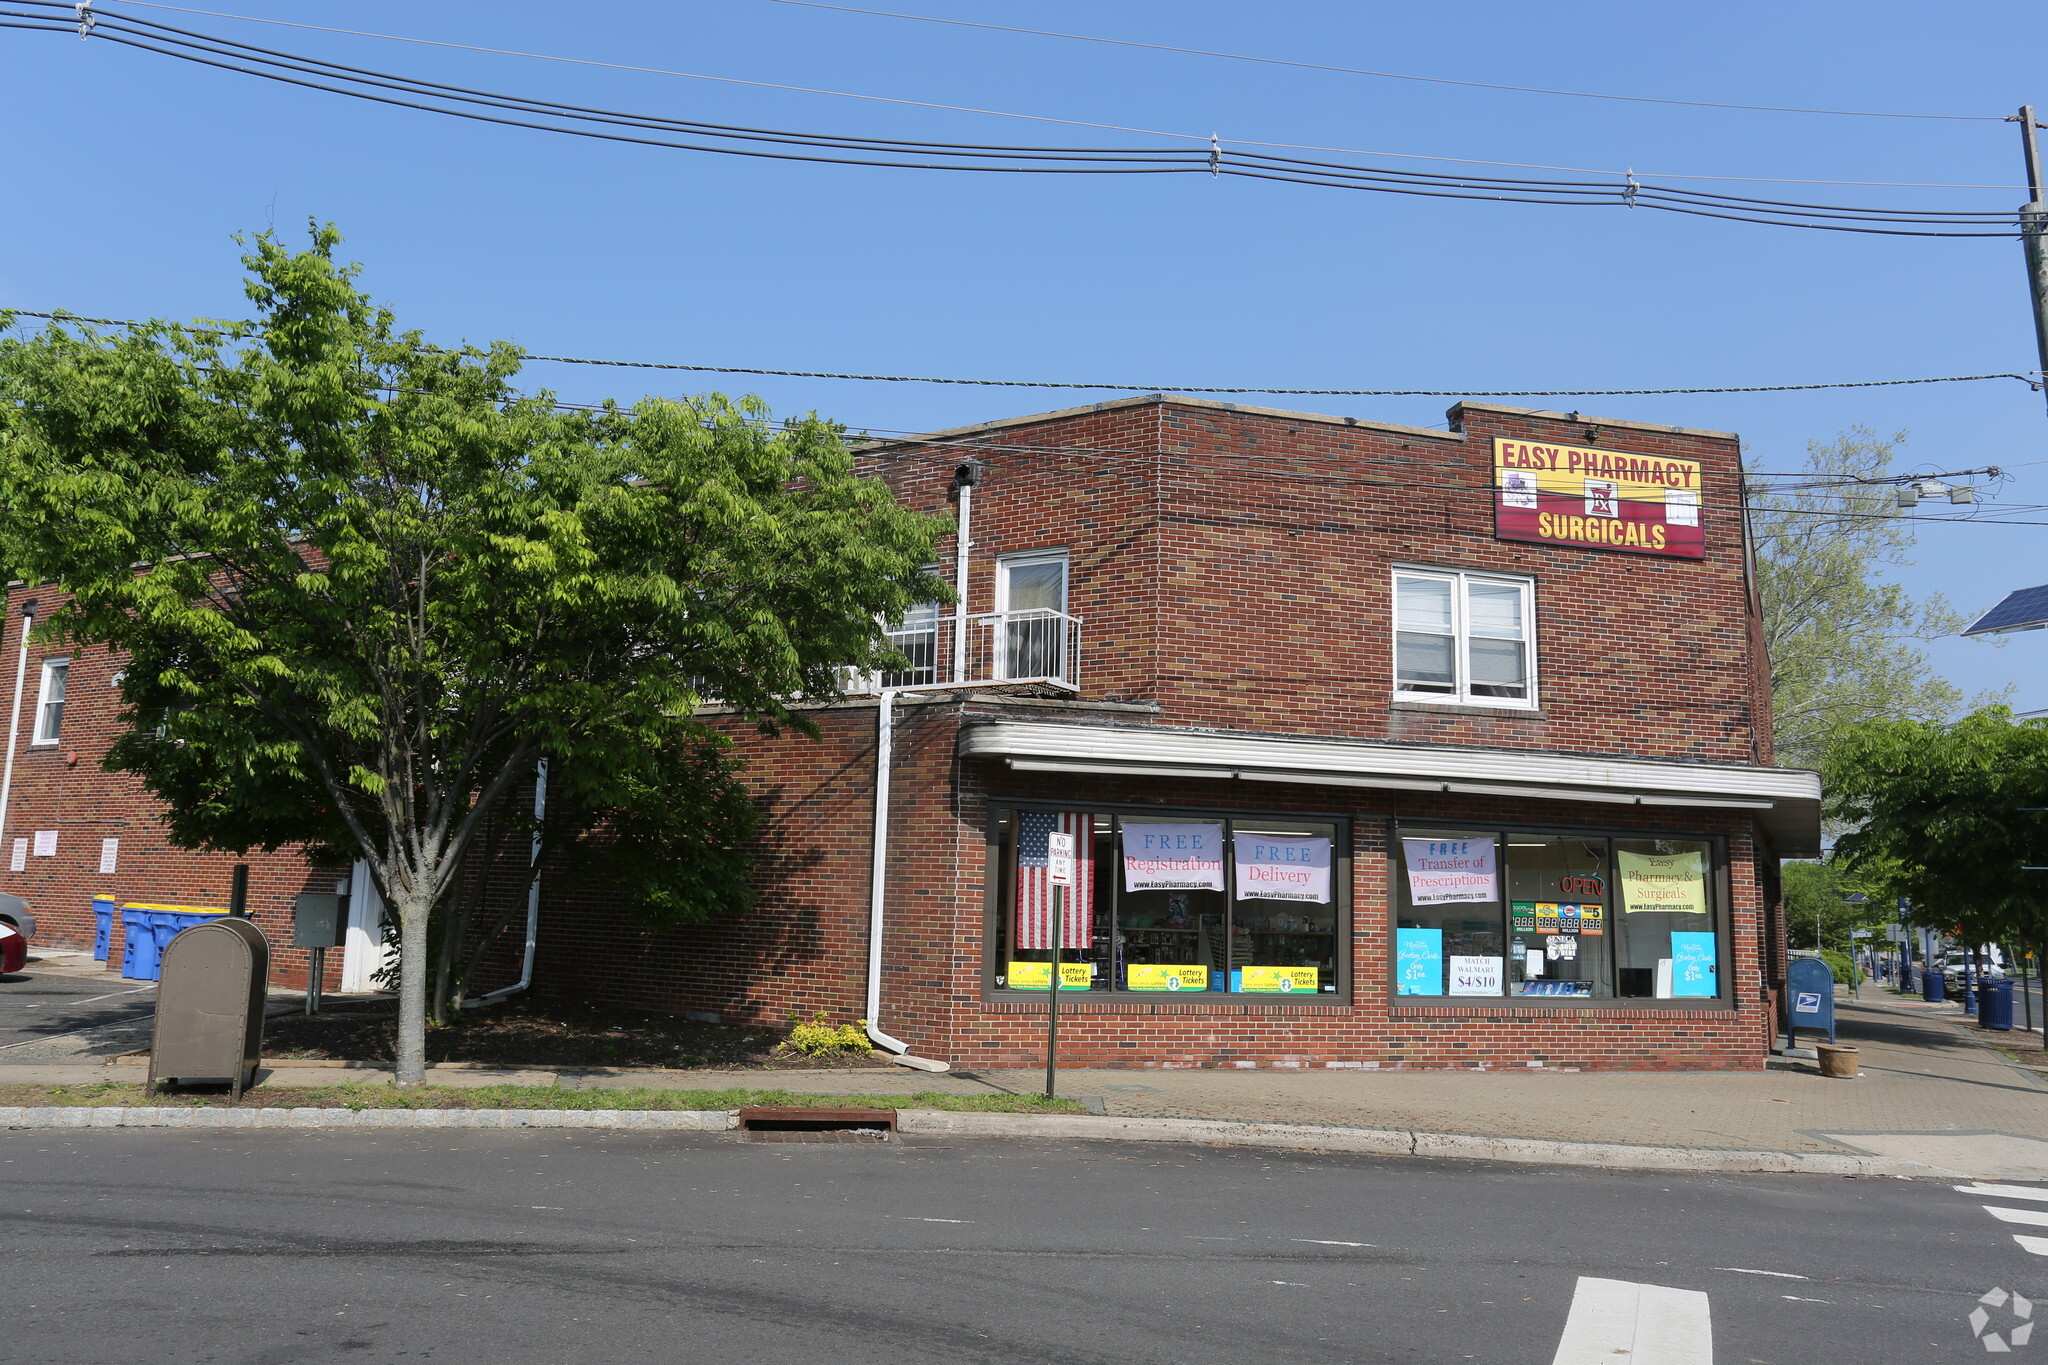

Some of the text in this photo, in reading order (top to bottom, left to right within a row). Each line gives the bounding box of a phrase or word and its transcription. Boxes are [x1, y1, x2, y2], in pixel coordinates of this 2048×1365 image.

[1502, 443, 1693, 487] EASY PHARMACY
[1538, 511, 1666, 550] SURGICALS
[1057, 836, 1066, 847] NO
[1143, 834, 1203, 849] FREE
[1051, 847, 1071, 859] PARKING
[1254, 845, 1311, 862] FREE
[1429, 842, 1468, 855] FREE
[1125, 855, 1222, 874] Registration
[1418, 856, 1486, 870] Transfer of
[1648, 857, 1675, 869] Easy
[1248, 866, 1312, 886] Delivery
[1412, 873, 1490, 888] Prescriptions
[1628, 871, 1694, 885] Pharmacy &
[1561, 877, 1603, 896] OPEN
[1637, 887, 1687, 901] Surgicals
[1546, 935, 1576, 943] SENECA
[1061, 967, 1087, 975] Lottery
[1179, 969, 1203, 978] Lottery
[1290, 971, 1314, 979] Lottery
[1065, 975, 1088, 983] Tickets
[1183, 976, 1205, 984] Tickets
[1294, 978, 1316, 986] Tickets
[1458, 976, 1495, 987] $4/$10
